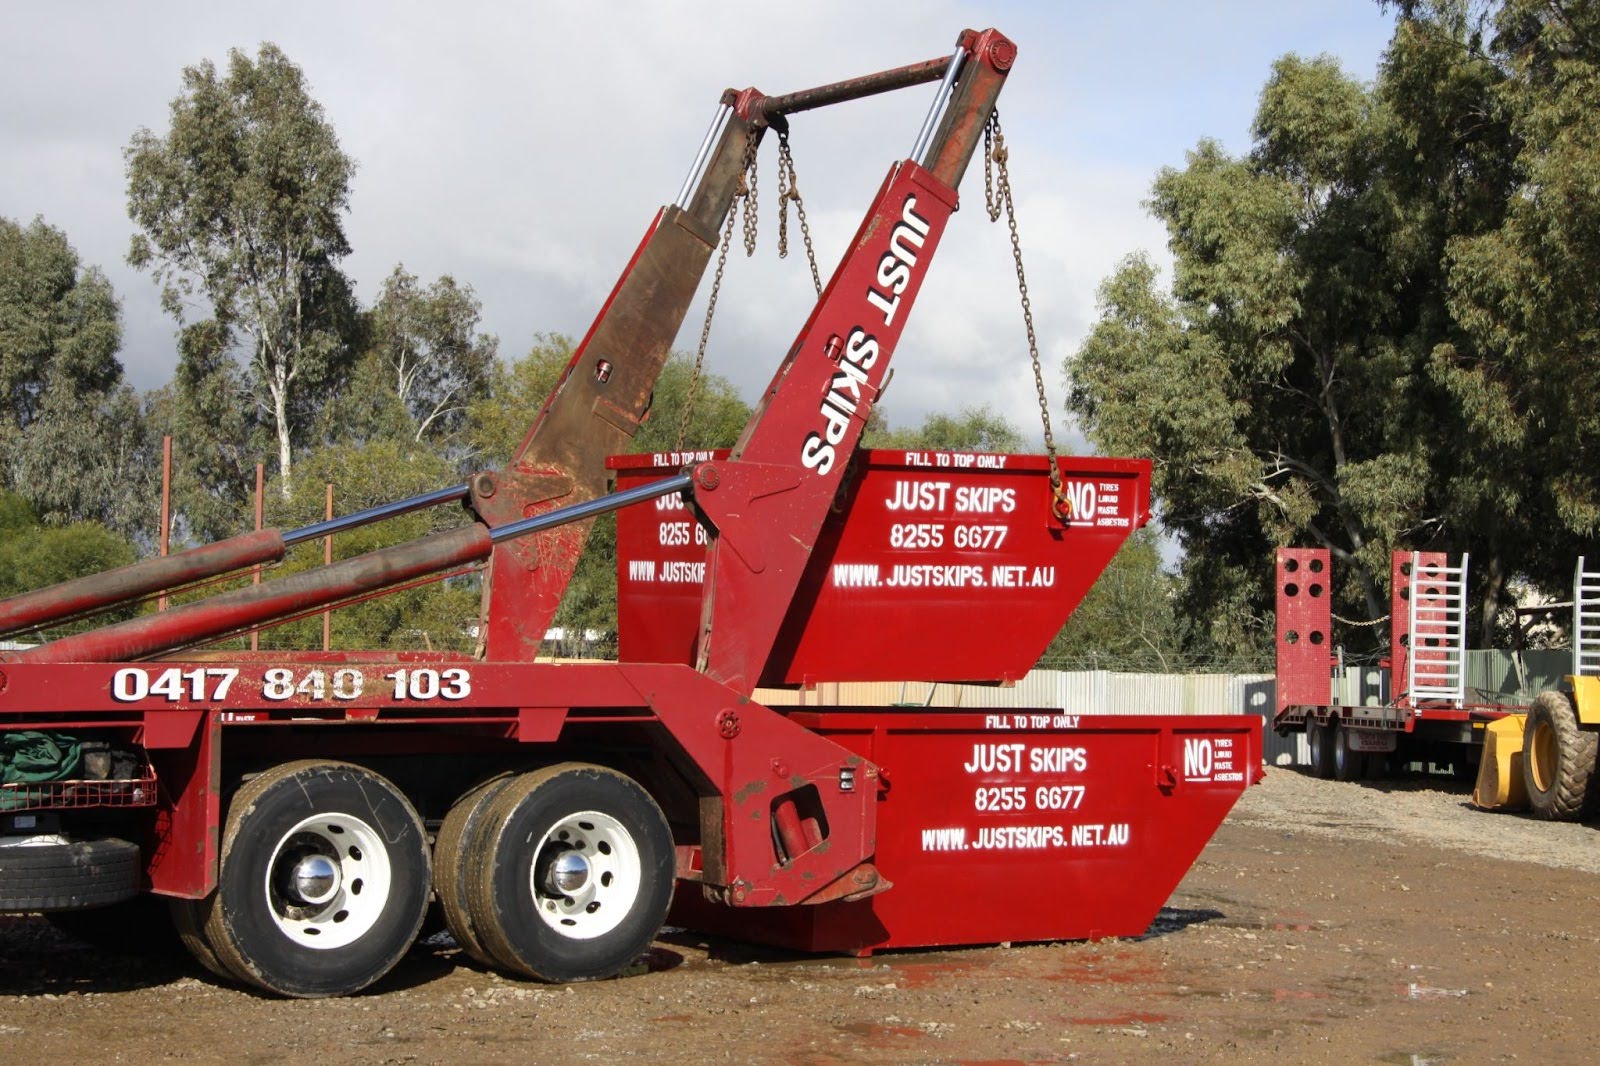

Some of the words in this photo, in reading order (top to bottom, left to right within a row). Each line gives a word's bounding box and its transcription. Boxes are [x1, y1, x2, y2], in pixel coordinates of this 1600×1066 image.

[866, 194, 931, 327] JUST
[801, 329, 880, 477] SKIPS
[654, 454, 669, 466] FILL
[671, 453, 679, 465] TO
[681, 452, 694, 465] TOP
[906, 452, 931, 466] FILL
[936, 453, 950, 466] TO
[953, 453, 975, 467] TOP
[977, 455, 1006, 468] ONLY
[886, 481, 950, 511] JUST
[955, 487, 1015, 512] SKIPS
[1067, 482, 1096, 520] NO
[660, 522, 689, 545] 8255
[890, 524, 944, 548] 8255
[954, 525, 1007, 549] 6677
[113, 667, 240, 702] 0417
[263, 667, 364, 701] 840
[386, 667, 472, 700] 103
[986, 715, 1010, 728] FILL
[1014, 716, 1027, 728] TO
[1030, 716, 1050, 728] TOP
[1053, 714, 1081, 728] ONLY
[965, 744, 1025, 773] JUST
[1030, 748, 1086, 772] SKIPS
[1185, 739, 1212, 776] NO
[975, 787, 1026, 810] 8255
[1036, 786, 1085, 809] 6677
